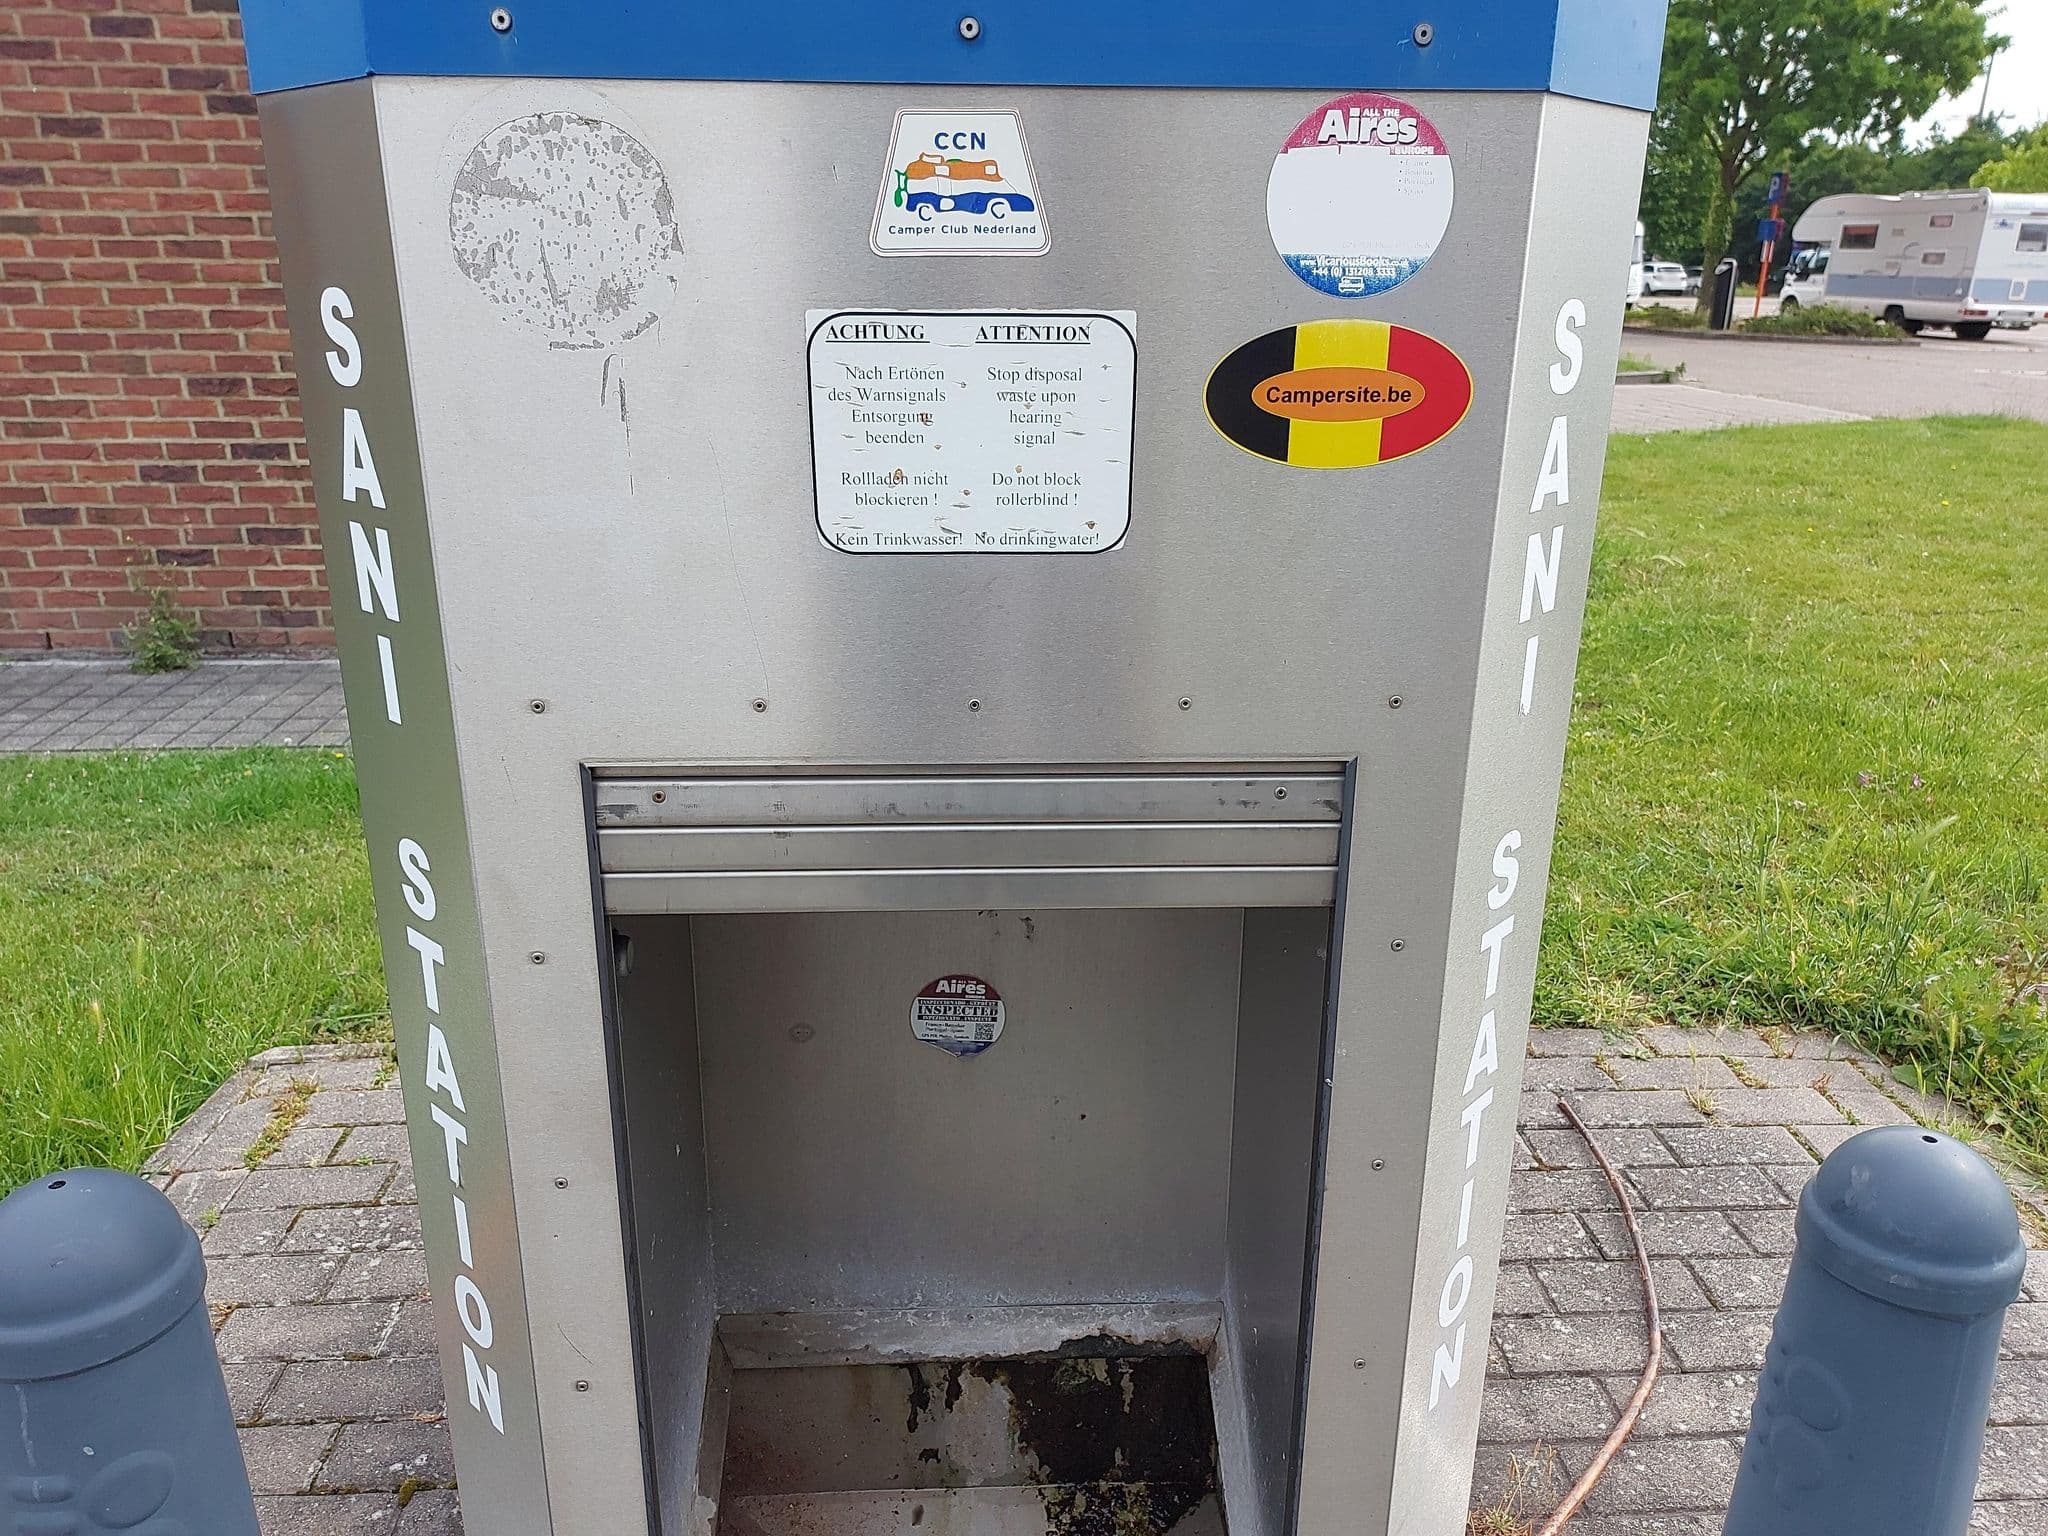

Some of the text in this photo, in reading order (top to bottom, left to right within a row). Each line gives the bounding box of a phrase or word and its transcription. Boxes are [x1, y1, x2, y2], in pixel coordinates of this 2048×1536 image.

[1362, 108, 1400, 117] ALL THE
[1318, 108, 1418, 144] Aires
[934, 132, 986, 150] CCN
[1769, 176, 1780, 199] P
[888, 224, 1036, 236] Camper Club Nederland
[826, 324, 925, 340] ACHTUNG
[976, 325, 1091, 341] ATTENTION
[846, 366, 945, 380] Nach Ertönen
[987, 367, 1082, 383] Stop disposal
[828, 387, 946, 404] des Warnsignals
[997, 391, 1076, 406] waste upon
[1266, 386, 1412, 407] Campersite.be
[851, 409, 934, 425] Entsorgung
[1009, 409, 1062, 426] hearing
[865, 430, 924, 444] beenden
[1013, 431, 1056, 447] signal
[914, 472, 948, 486] nicht
[992, 472, 1082, 486] Do not block
[320, 286, 402, 725] SANI
[855, 492, 929, 506] blockieren
[996, 492, 1069, 506] rollerblind
[1518, 298, 1586, 717] SANI
[835, 532, 963, 546] Kein Trinkwasser!
[975, 532, 1099, 548] No drinkingwater!
[936, 980, 986, 994] Aires
[918, 1005, 998, 1016] INSPECTED
[1429, 828, 1522, 1413] STATION
[399, 837, 504, 1435] STATION
